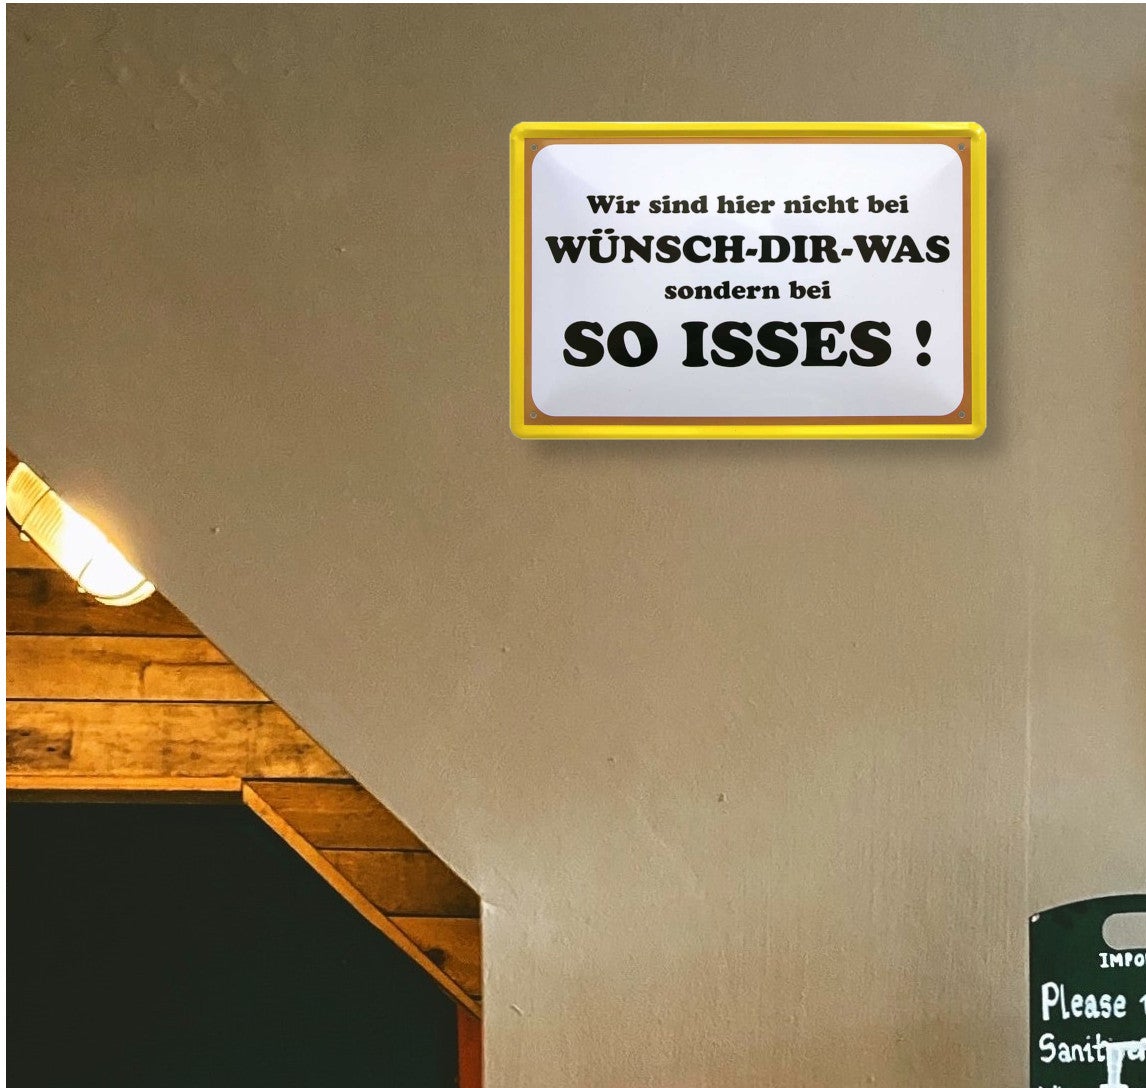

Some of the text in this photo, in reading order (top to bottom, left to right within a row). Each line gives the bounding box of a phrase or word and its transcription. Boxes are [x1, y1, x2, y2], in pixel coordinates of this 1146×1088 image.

[586, 195, 909, 214] Wir sind hier nicht bei
[545, 228, 950, 264] WÜNSCH-DIR-WAS
[664, 281, 832, 300] sondern bei
[562, 320, 659, 368] SO
[681, 320, 892, 368] ISSES
[1041, 982, 1127, 1021] Please
